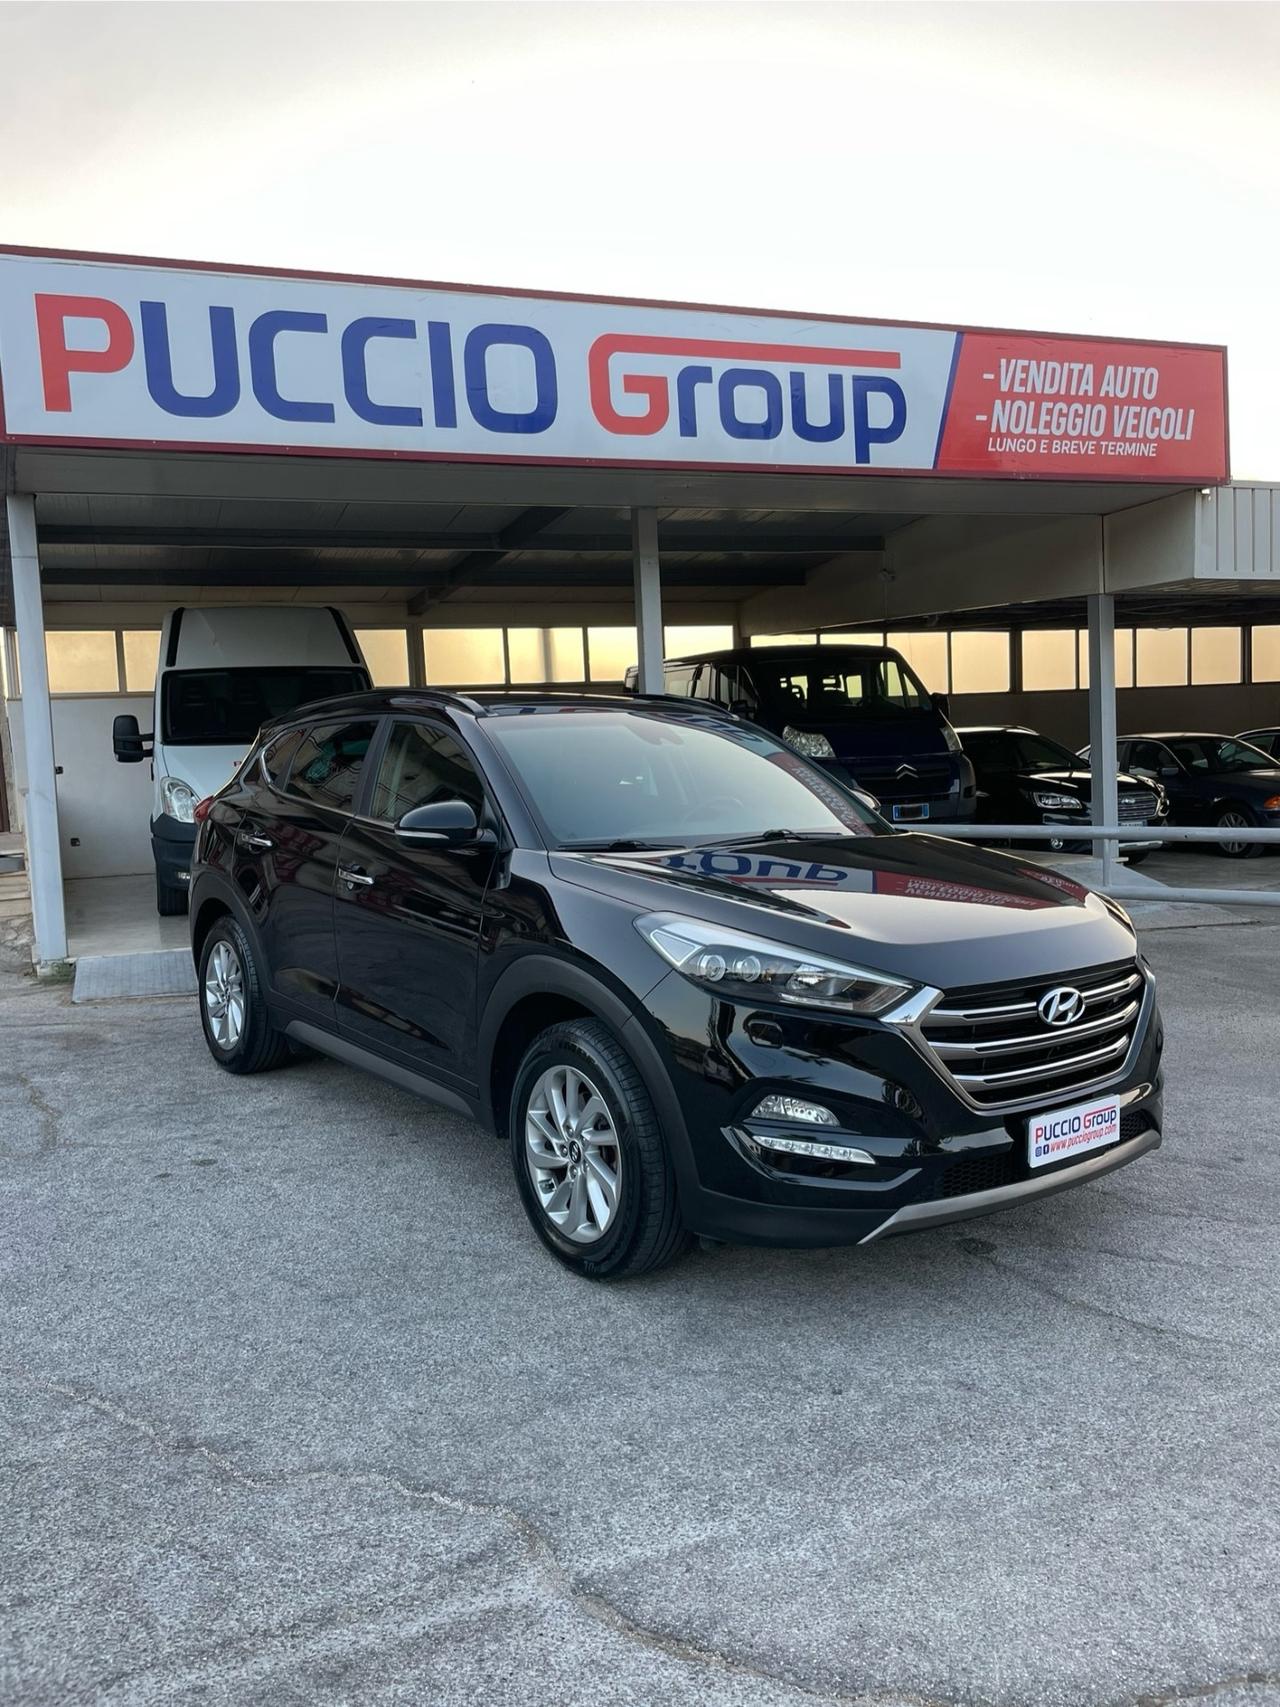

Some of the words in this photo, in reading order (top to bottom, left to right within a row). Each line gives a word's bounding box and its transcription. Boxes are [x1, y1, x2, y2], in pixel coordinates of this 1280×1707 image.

[34, 293, 558, 434] PUCCIO
[1099, 365, 1160, 400] AUTO
[1112, 404, 1195, 440] VEICOLI
[988, 438, 1036, 453] LUNGO
[1040, 439, 1048, 453] E
[1052, 440, 1096, 455] BREVE
[1100, 441, 1157, 457] TERMINE
[1035, 1116, 1082, 1144] PUCCIO
